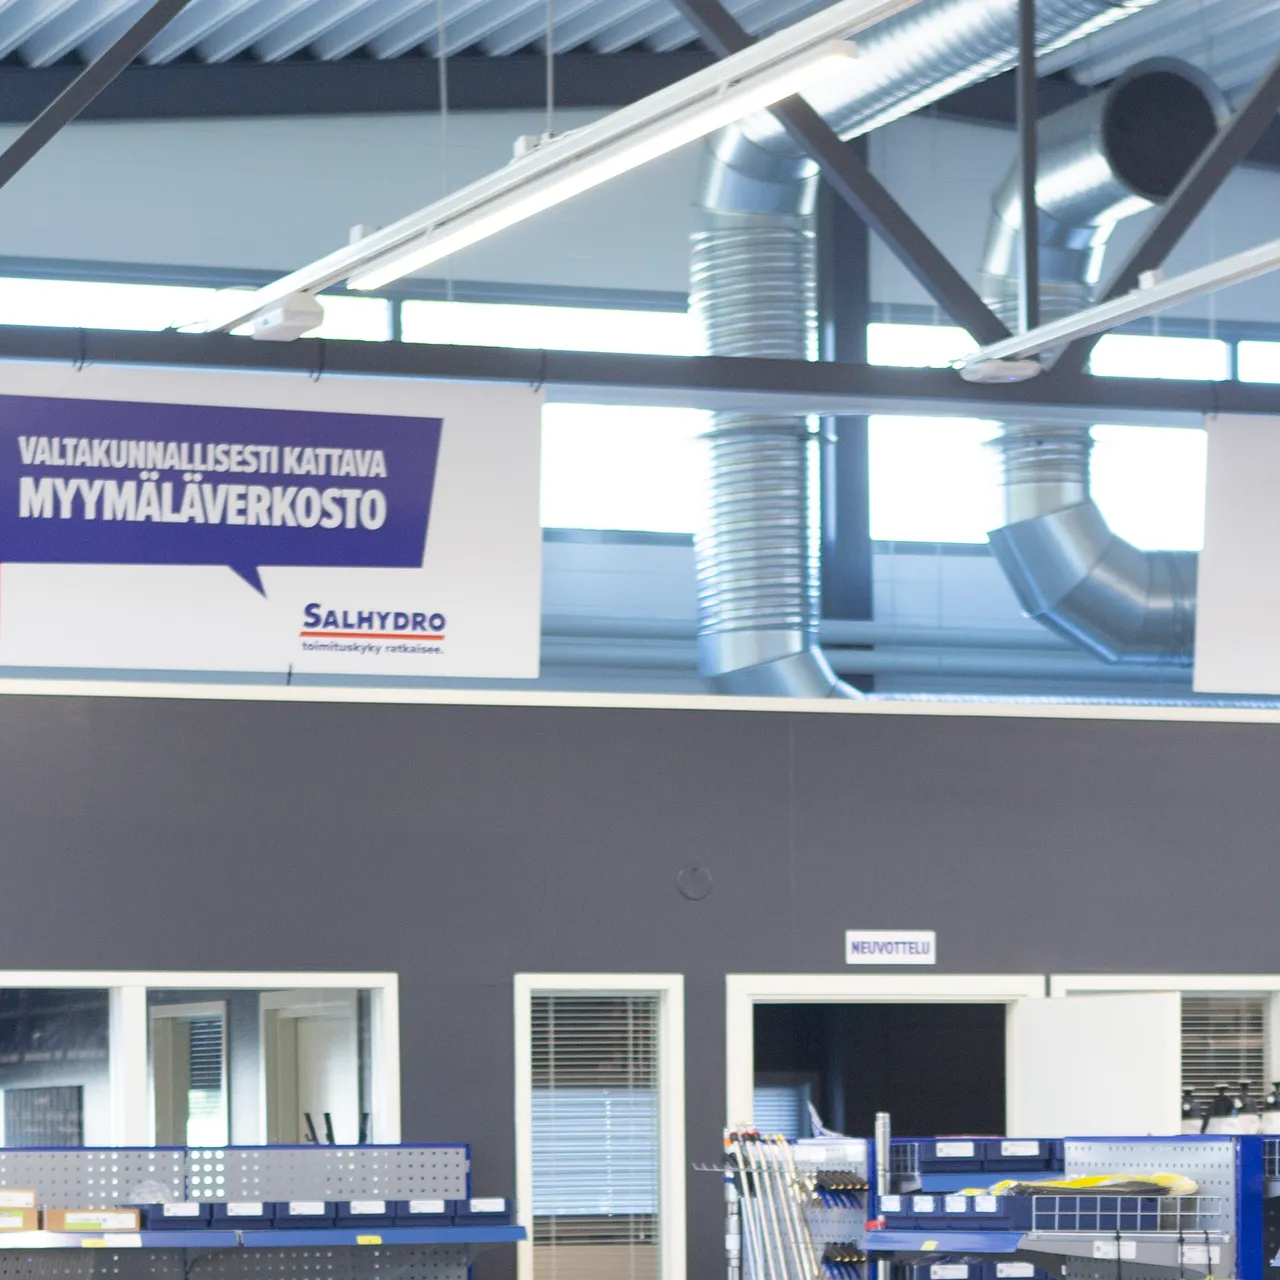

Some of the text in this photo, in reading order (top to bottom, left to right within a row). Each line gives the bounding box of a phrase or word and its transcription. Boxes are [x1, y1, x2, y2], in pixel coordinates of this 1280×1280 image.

[18, 436, 388, 478] VALTAKUNNALLISESTI KATTAVA
[19, 471, 388, 531] MYYMÄLÄVERKOSTO
[302, 602, 446, 632] SALHYDRO
[302, 641, 445, 655] toimituskyky ratkaisee.
[851, 941, 930, 955] NEUVOTTELU
